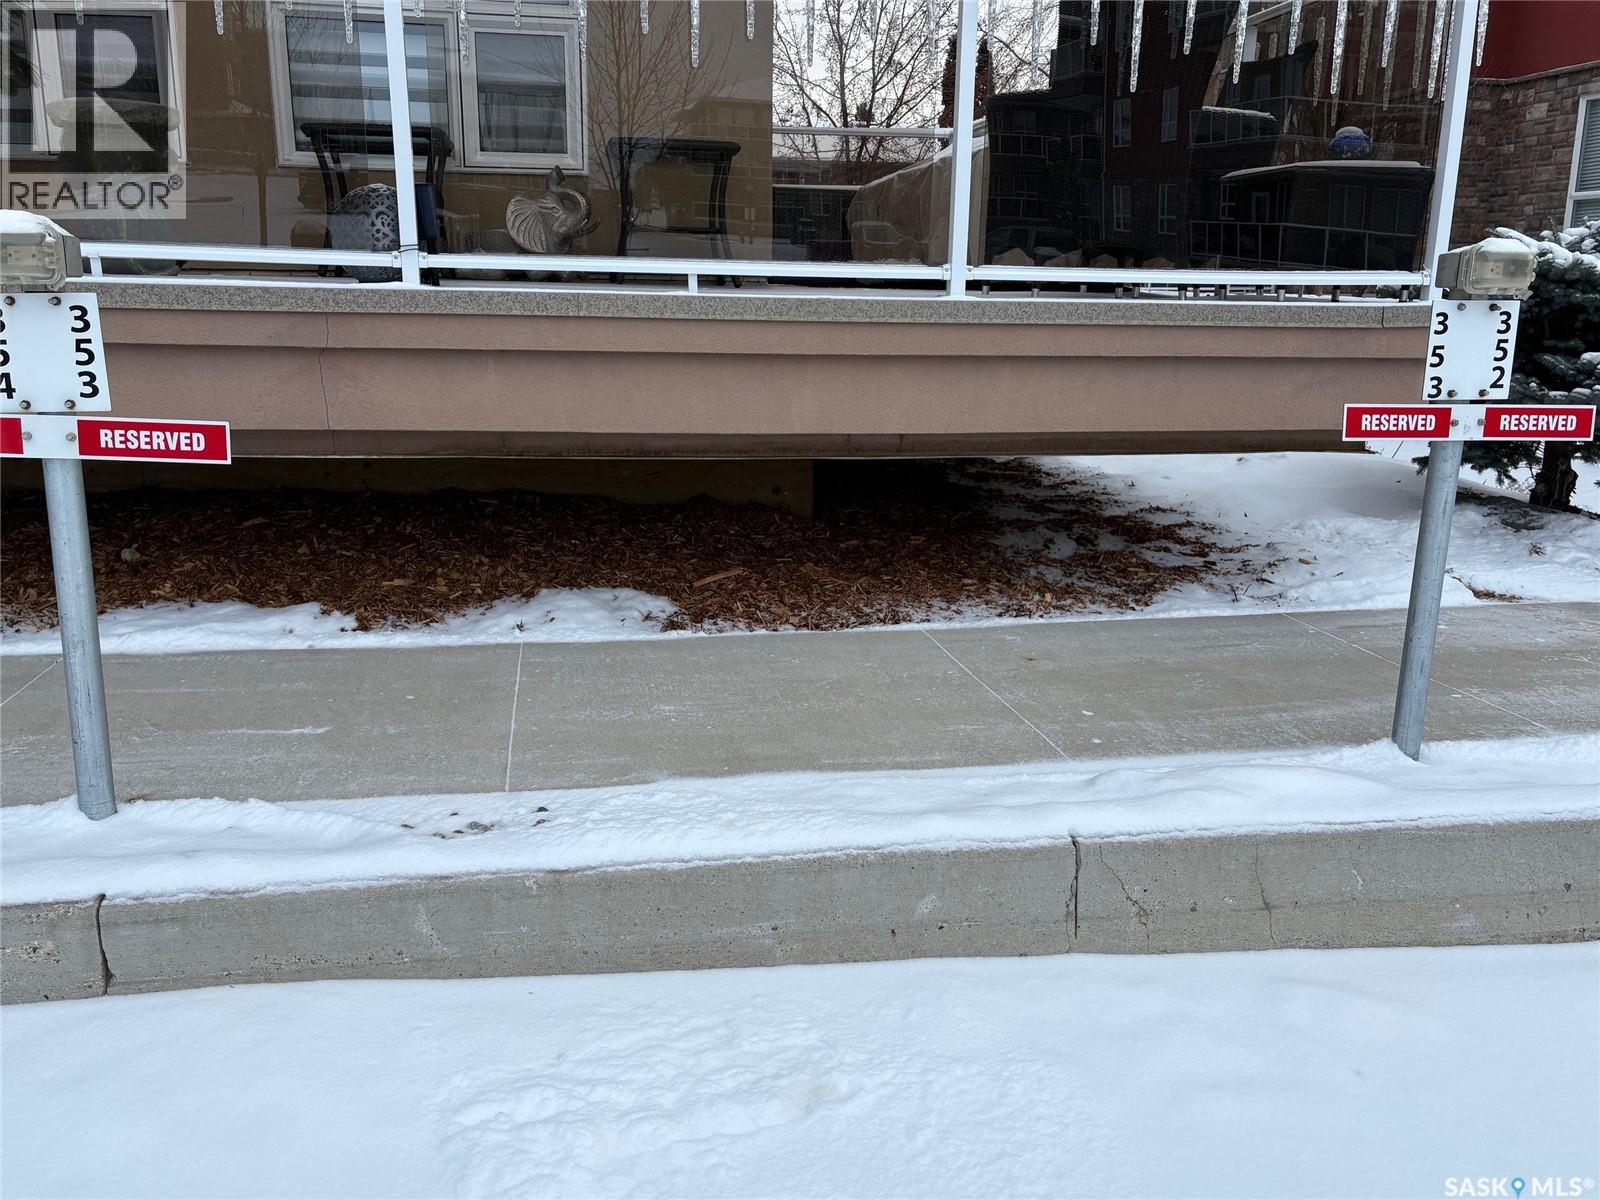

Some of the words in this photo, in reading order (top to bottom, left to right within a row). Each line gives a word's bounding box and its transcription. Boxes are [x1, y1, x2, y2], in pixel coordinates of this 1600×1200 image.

[69, 305, 100, 398] 353
[1427, 312, 1449, 398] 353
[1489, 311, 1512, 389] 352
[100, 429, 205, 452] RESERVED
[1361, 414, 1436, 431] RESERVED
[1499, 414, 1577, 431] RESERVED
